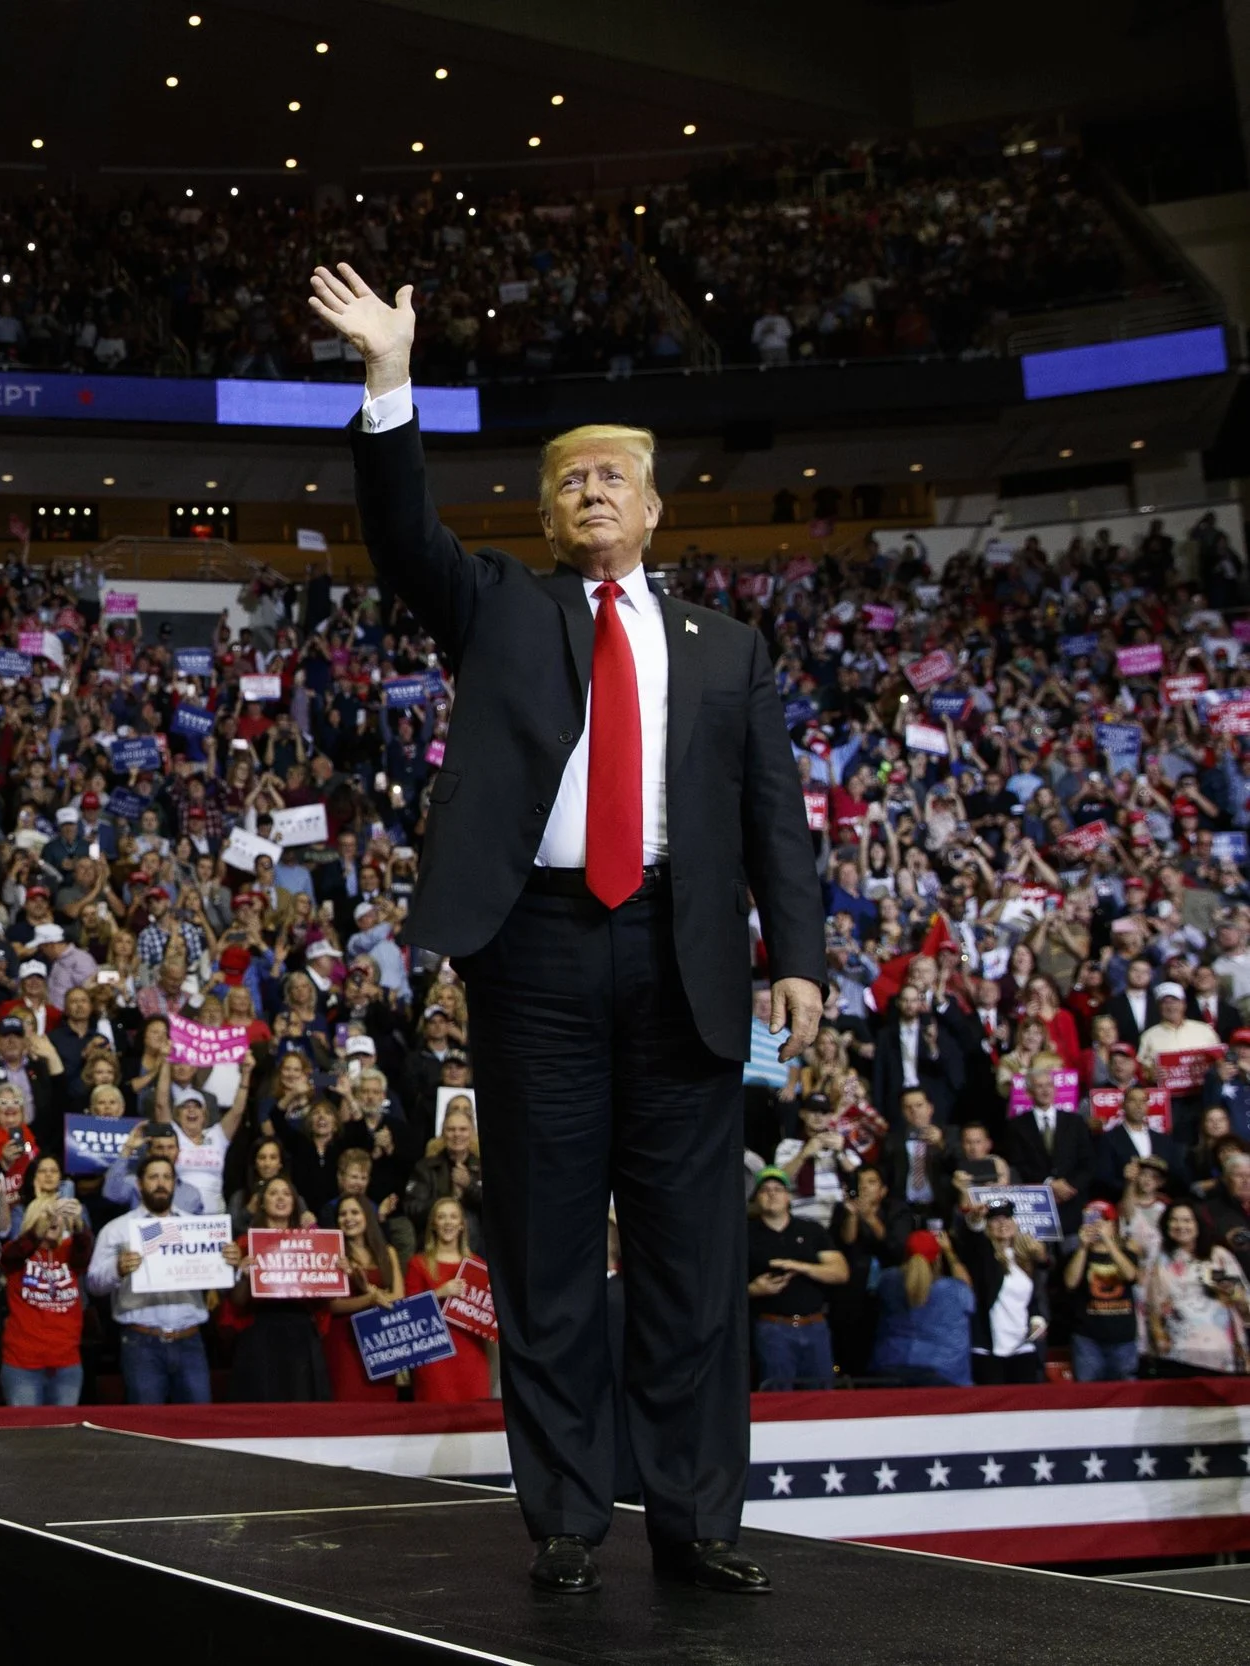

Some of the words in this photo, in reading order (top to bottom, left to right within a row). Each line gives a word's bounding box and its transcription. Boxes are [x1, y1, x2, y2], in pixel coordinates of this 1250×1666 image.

[168, 1012, 247, 1041] WOMEN
[173, 1043, 246, 1065] TRUMP
[192, 1038, 221, 1052] FOR
[72, 1129, 130, 1145] TRUM
[177, 1222, 227, 1231] VETERANS
[159, 1241, 224, 1256] TRUMP
[280, 1238, 312, 1250] MAKE
[255, 1252, 339, 1270] AMERICA
[259, 1271, 299, 1284] GREAT
[300, 1271, 339, 1284] AGAIN
[380, 1308, 411, 1327] MAKE
[450, 1297, 494, 1325] PROUD
[362, 1315, 445, 1351] AMERICA
[366, 1343, 411, 1367] STRONG
[411, 1332, 449, 1354] AGAIN
